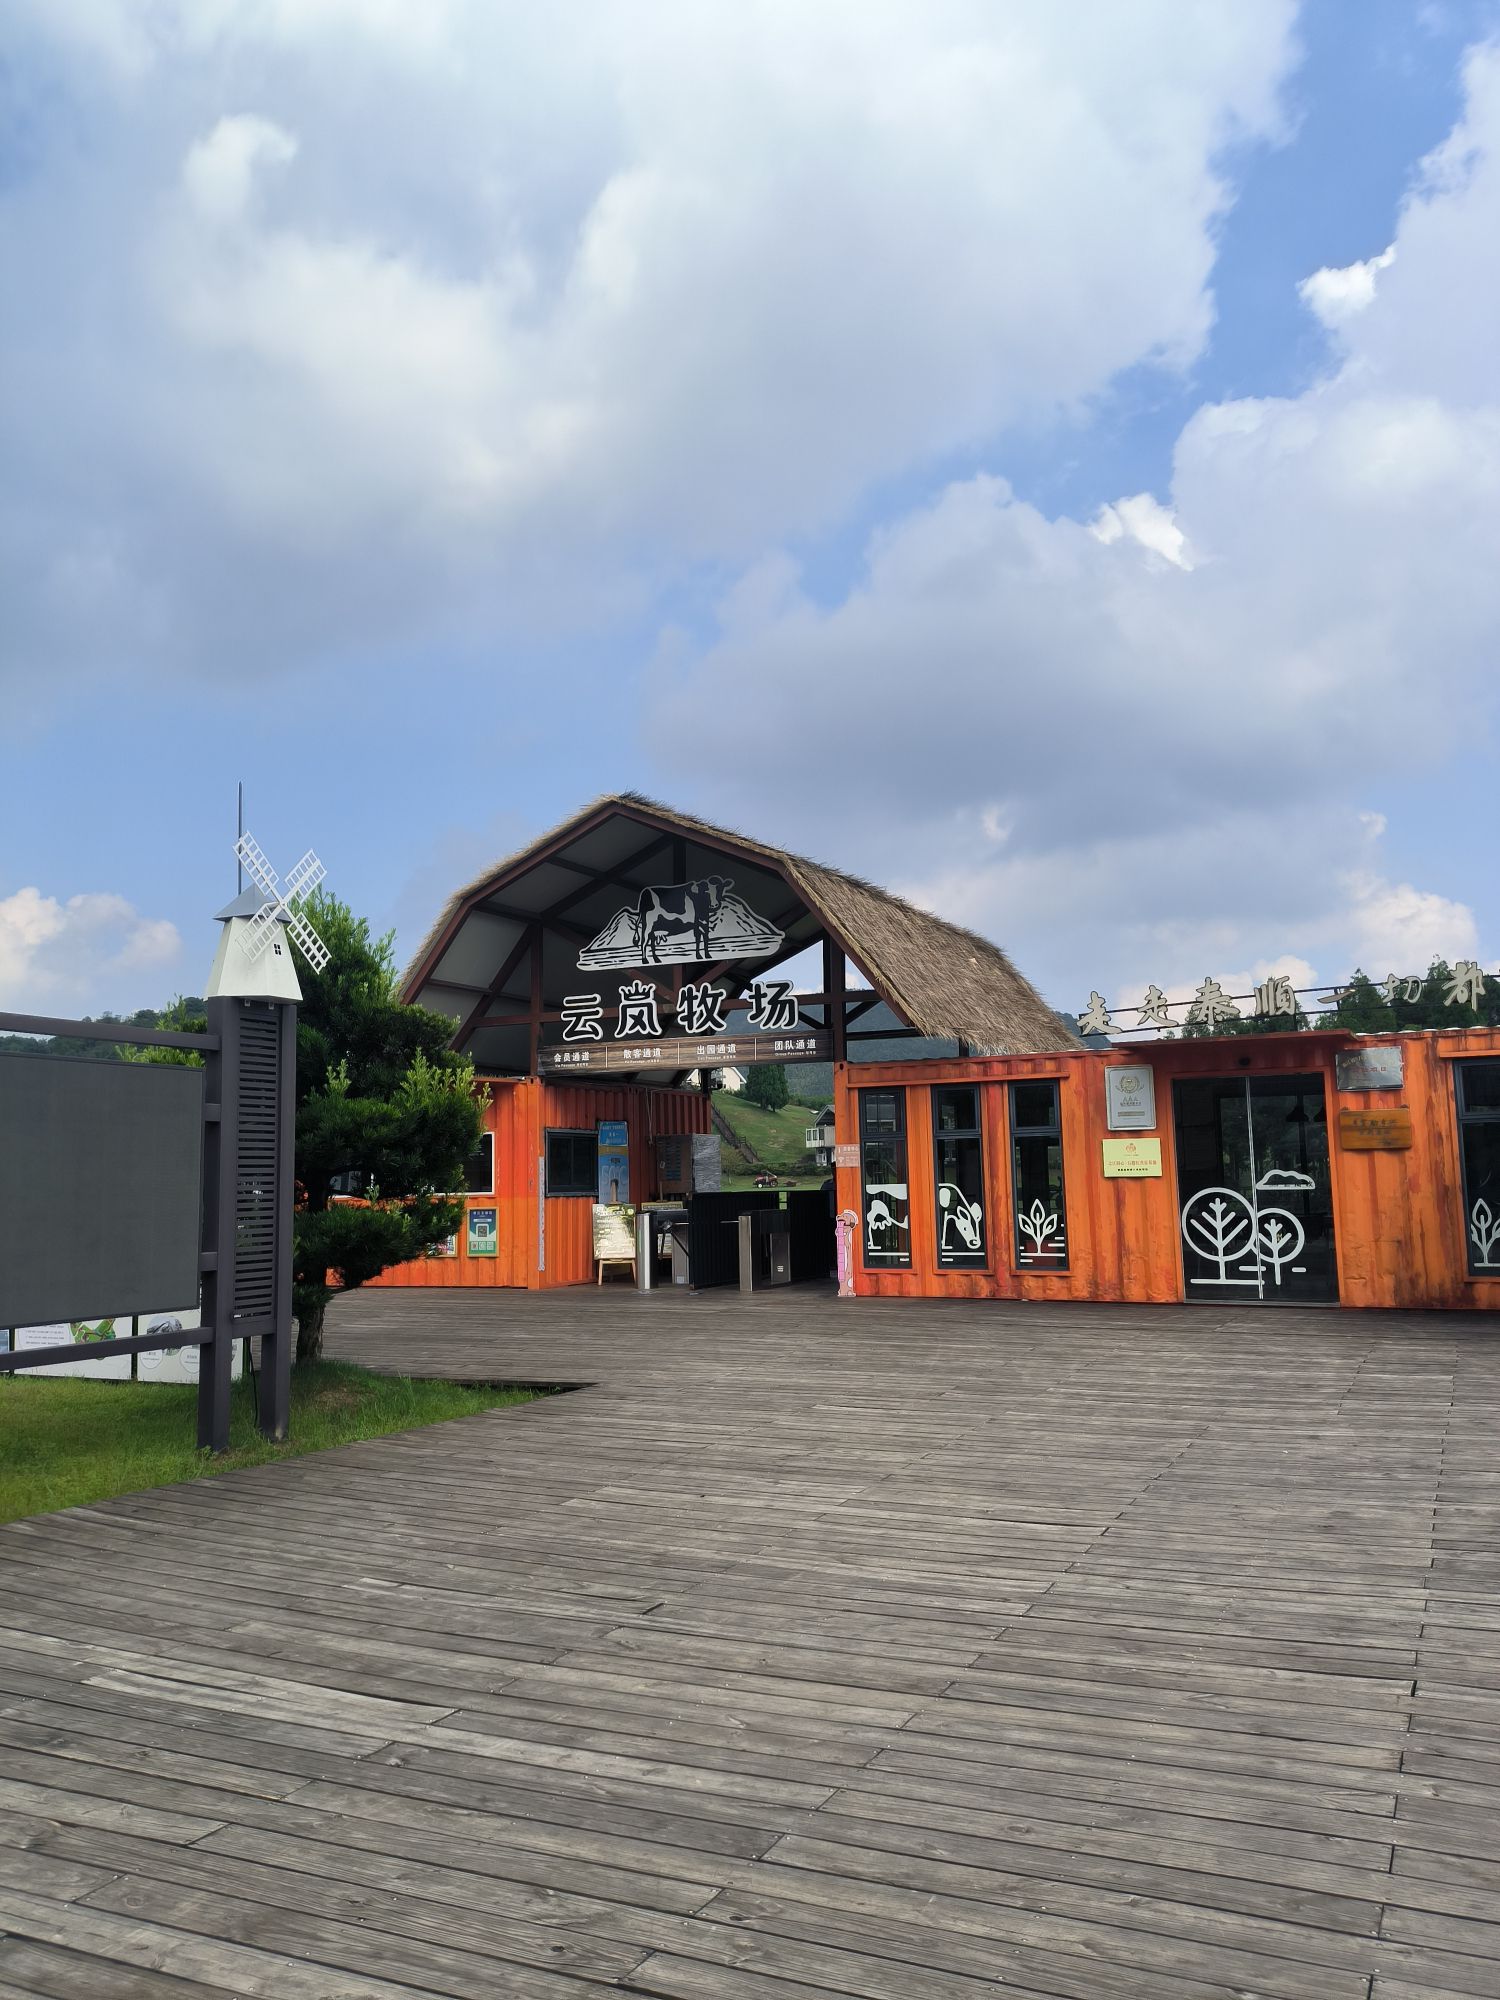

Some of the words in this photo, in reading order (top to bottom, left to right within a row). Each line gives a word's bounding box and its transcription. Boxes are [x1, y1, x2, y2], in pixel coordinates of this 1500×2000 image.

[561, 979, 799, 1041] 云岚牧场
[774, 1038, 816, 1051] 团队通道
[553, 1051, 590, 1063] 会员通道
[623, 1047, 662, 1059] 散客通道
